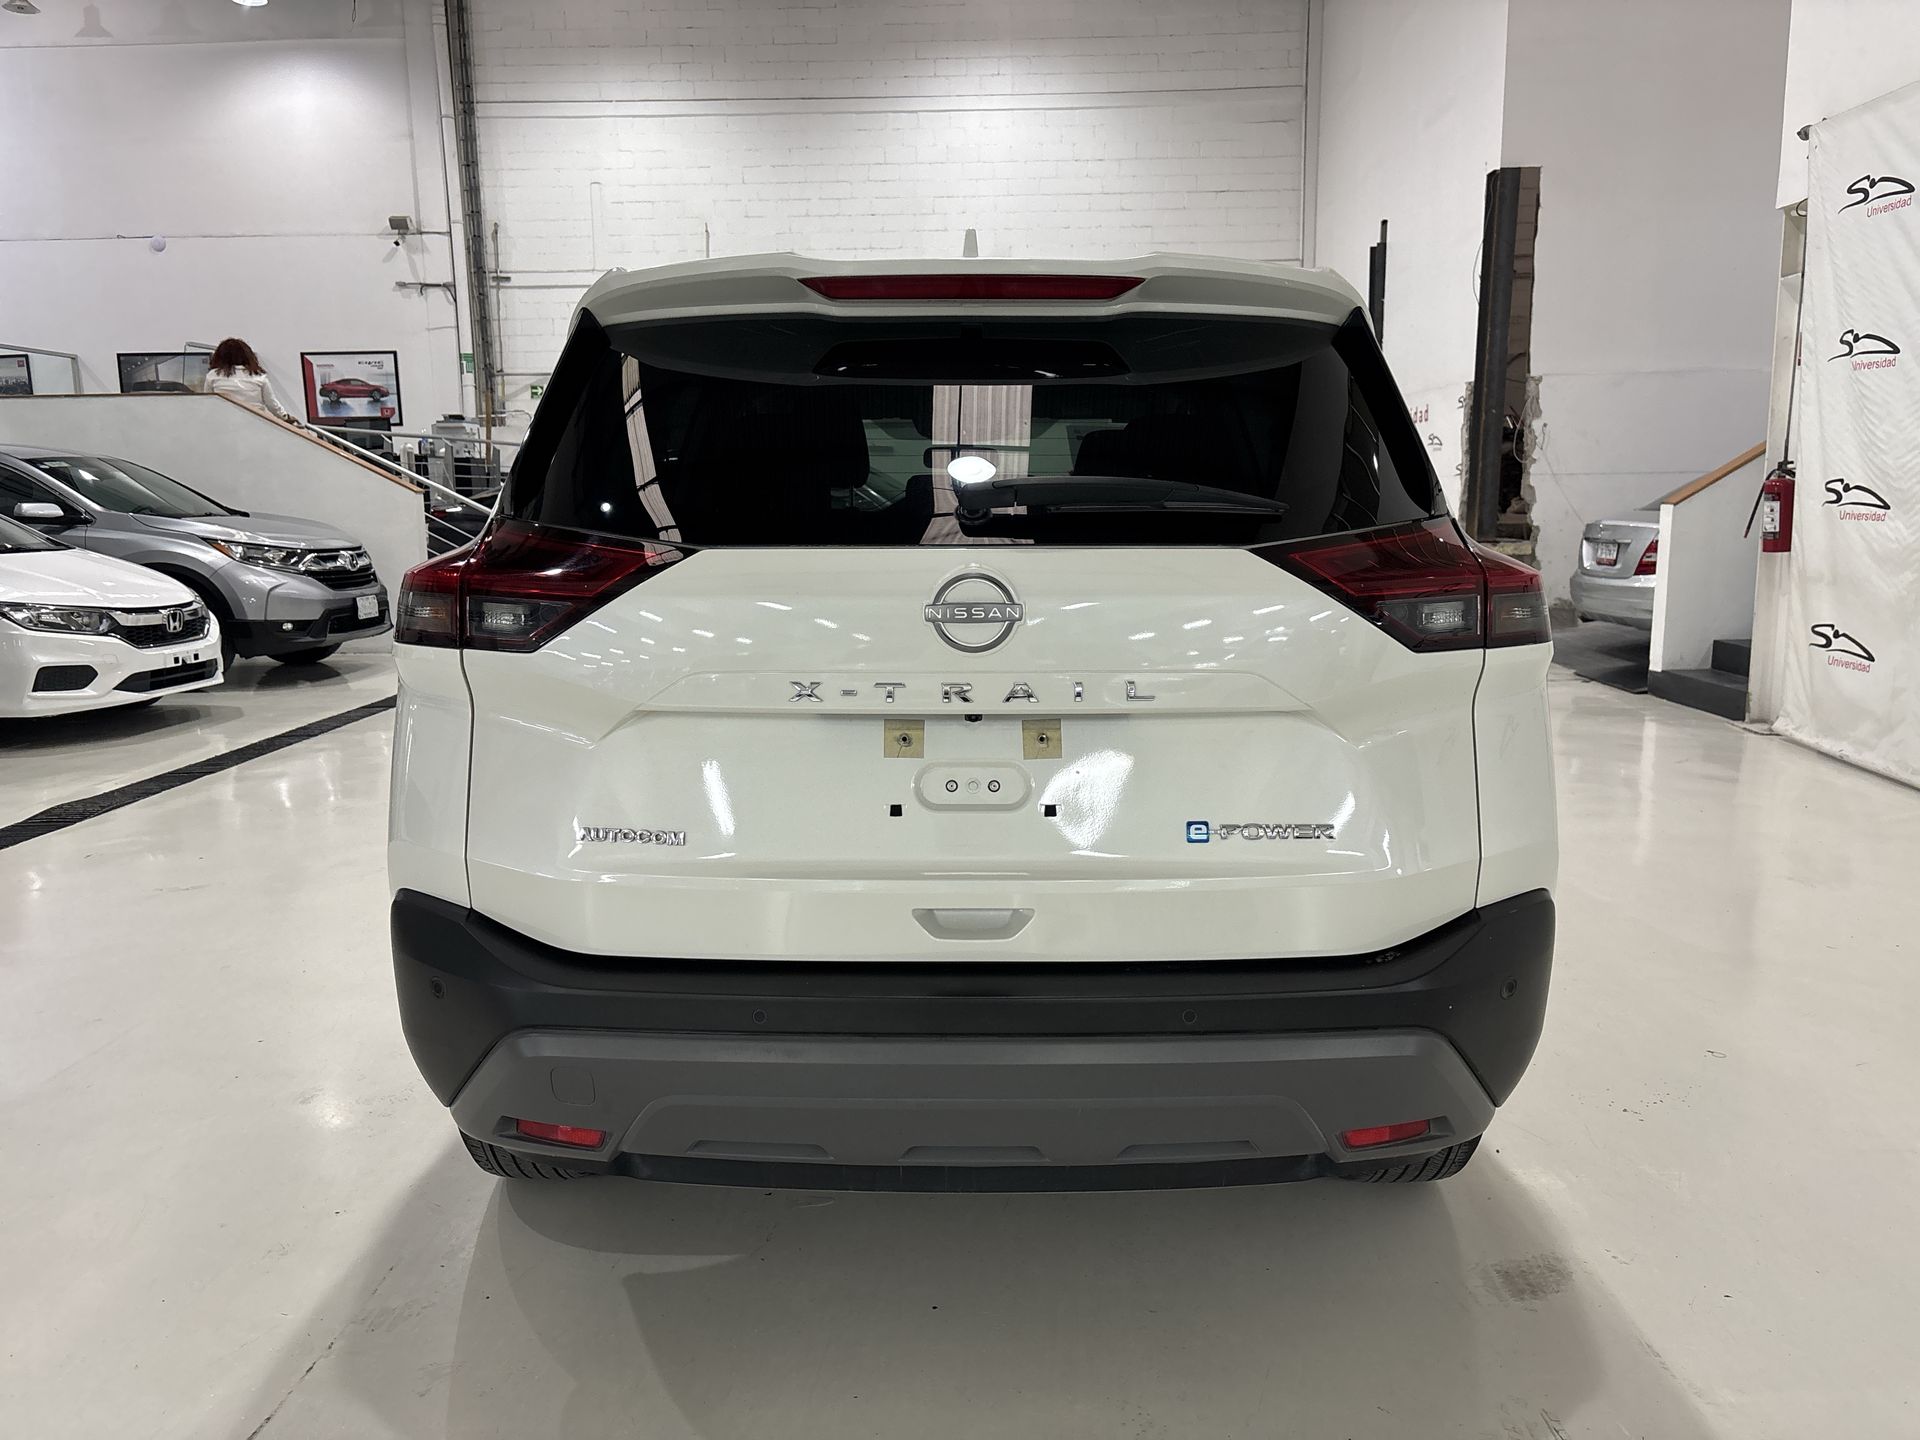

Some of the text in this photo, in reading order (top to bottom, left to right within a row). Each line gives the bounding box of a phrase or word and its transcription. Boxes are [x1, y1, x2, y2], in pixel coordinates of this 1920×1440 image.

[1866, 195, 1912, 218] Universidad
[1852, 356, 1897, 371] Universidad
[1840, 510, 1887, 522] Universidad
[928, 607, 1020, 619] NISSAN
[1827, 655, 1871, 673] Universidad
[788, 681, 1156, 704] X-TRAIL
[579, 826, 686, 847] AUTOCOM
[1187, 822, 1337, 842] e-POWER
